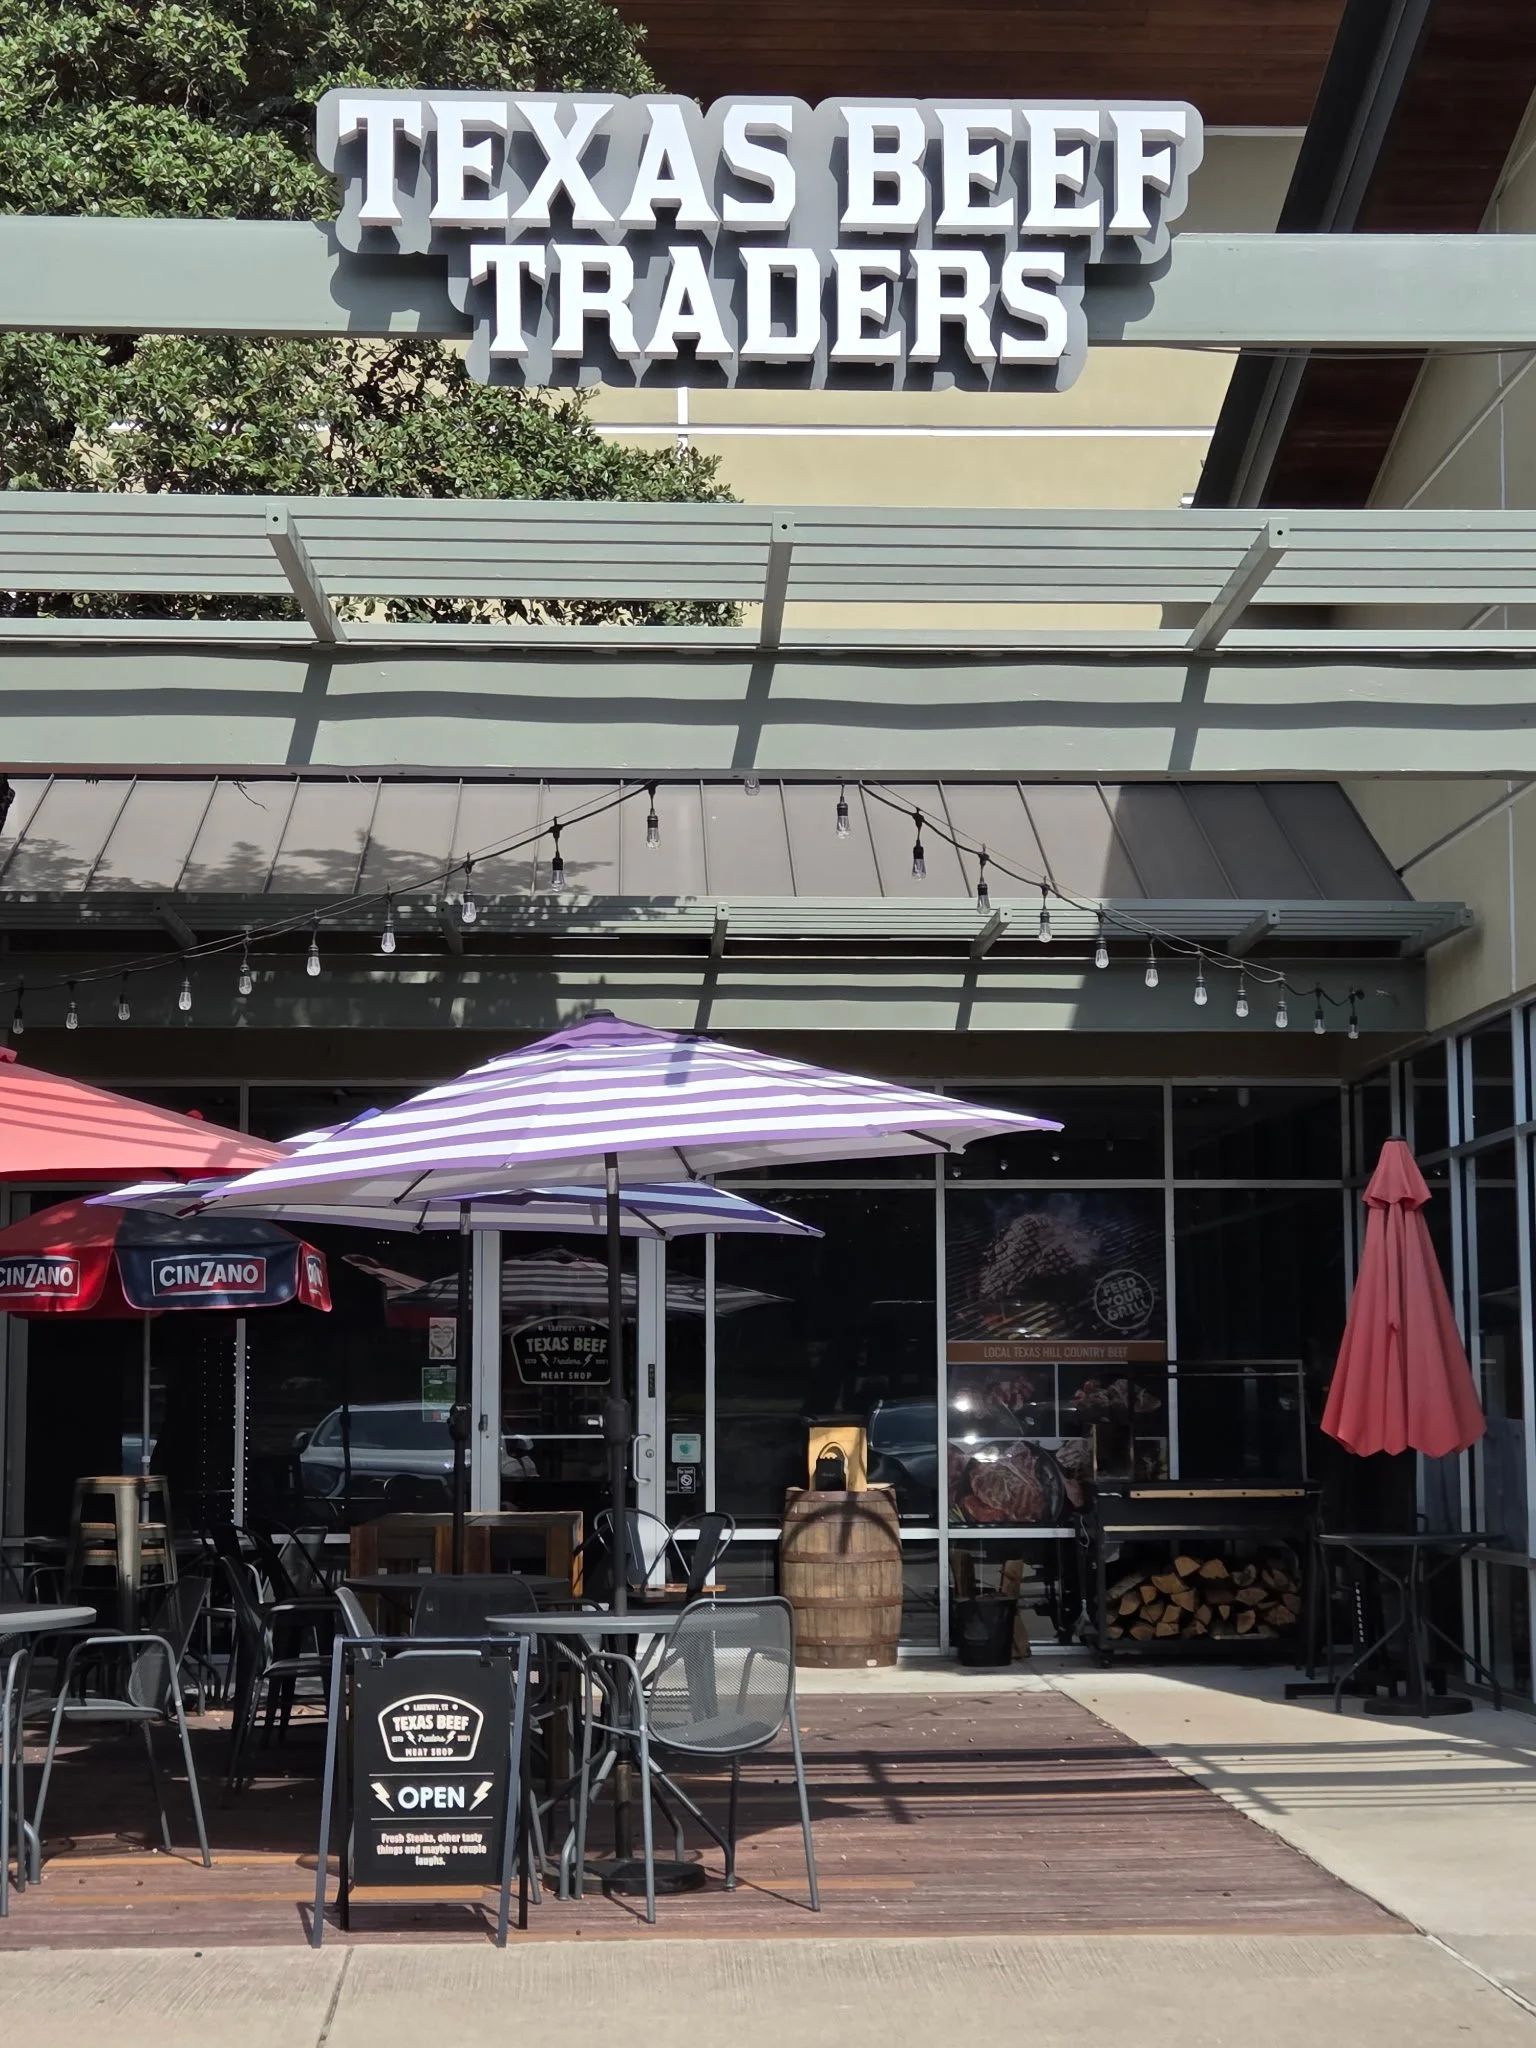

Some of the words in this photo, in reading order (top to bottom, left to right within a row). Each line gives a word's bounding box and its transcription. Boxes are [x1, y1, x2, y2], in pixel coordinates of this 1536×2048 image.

[337, 98, 796, 231] TEXAS
[837, 105, 1188, 237] BEEF
[469, 244, 1069, 364] TRADERS
[159, 1261, 259, 1287] CINZANO
[1102, 1276, 1137, 1297] FEED
[1099, 1287, 1145, 1305] YOUR
[1107, 1299, 1150, 1321] GRILL
[526, 1337, 570, 1352] TEXAS
[573, 1337, 608, 1353] BEEF
[983, 1346, 1011, 1358] LOCAL
[1014, 1346, 1040, 1358] TEXAS
[1042, 1346, 1061, 1358] HILL
[1064, 1346, 1105, 1358] COUNTRY
[1107, 1346, 1129, 1358] BEEF
[568, 1371, 593, 1380] SHOP
[392, 1714, 434, 1732] TEXAS
[436, 1714, 470, 1731] BEEF
[405, 1748, 429, 1756] MEAT
[430, 1747, 454, 1756] SHOP
[397, 1786, 465, 1809] OPEN
[381, 1833, 405, 1844] Fresh
[406, 1833, 436, 1844] Steaks,
[437, 1832, 461, 1843] other
[461, 1833, 483, 1844] tasty
[376, 1845, 403, 1856] things
[404, 1845, 421, 1855] and
[422, 1844, 451, 1855] maybe
[452, 1846, 458, 1854] a
[459, 1844, 488, 1855] couple
